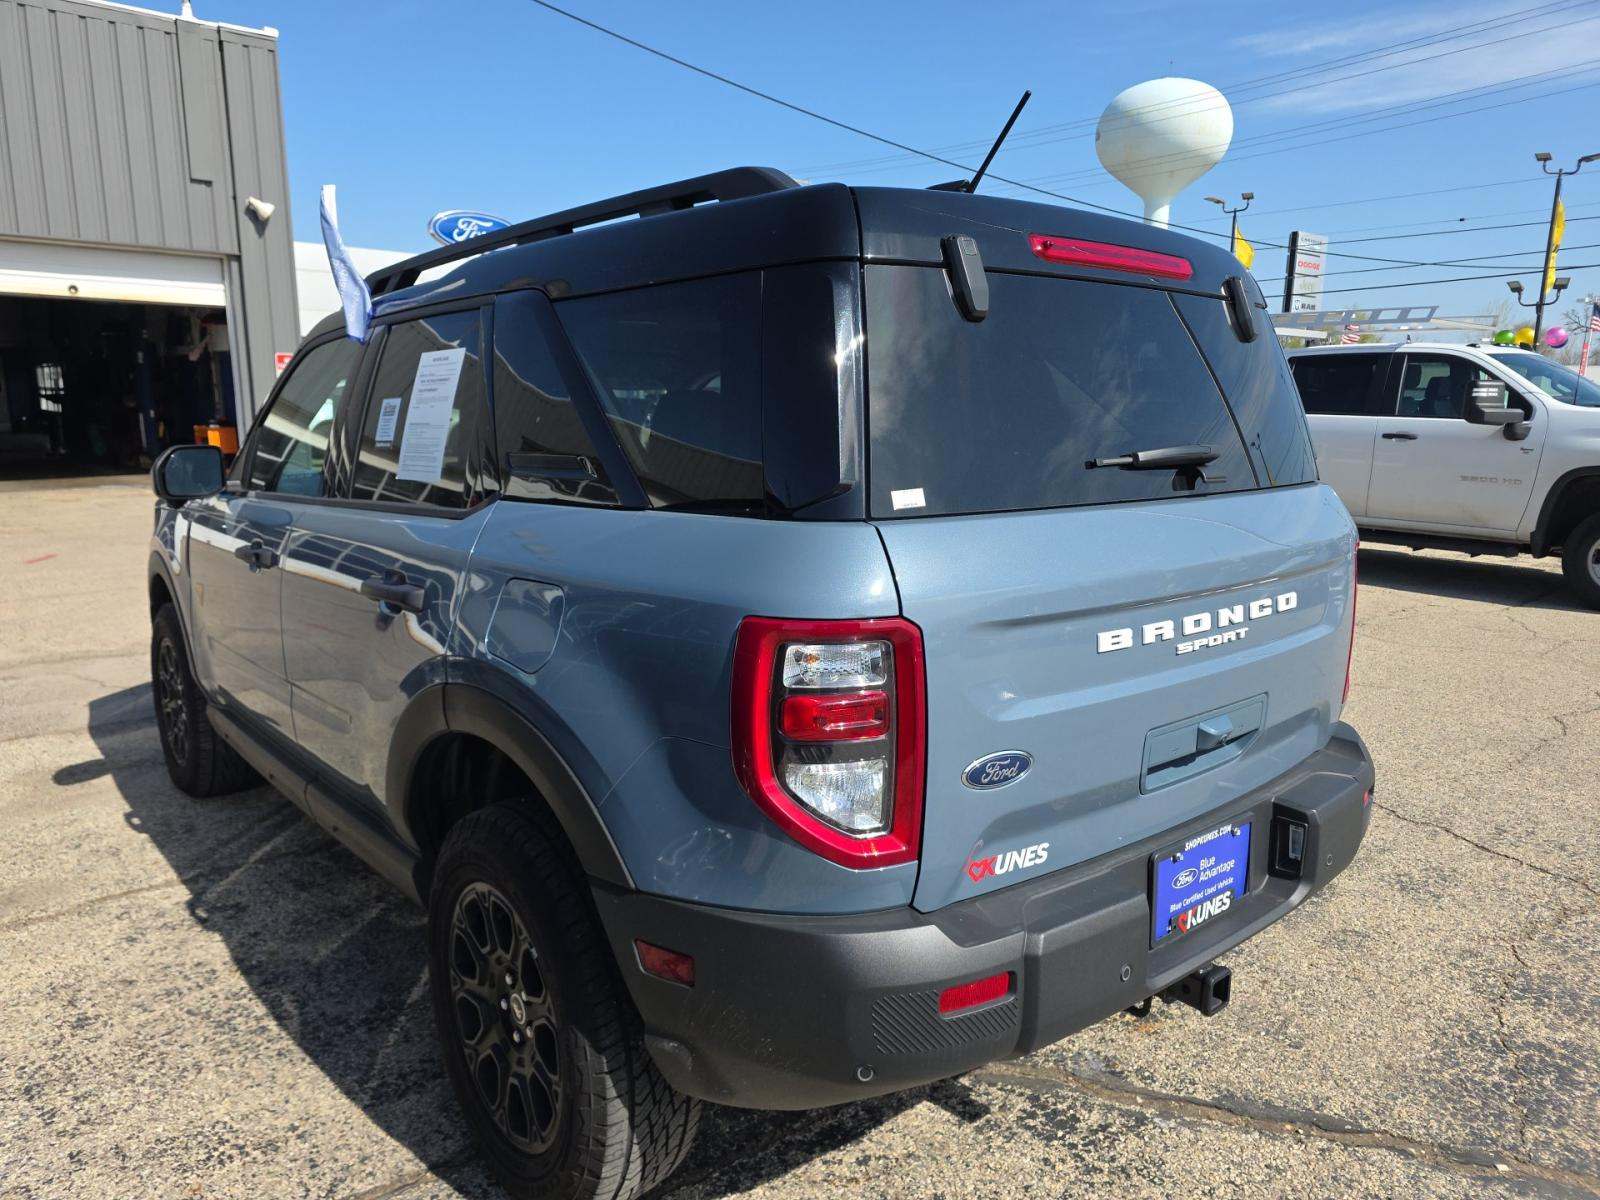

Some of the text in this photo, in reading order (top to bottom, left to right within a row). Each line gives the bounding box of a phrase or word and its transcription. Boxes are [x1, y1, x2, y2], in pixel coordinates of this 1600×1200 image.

[1097, 591, 1298, 653] BRONCO
[1176, 627, 1249, 656] SPORT
[981, 757, 1020, 784] Ford
[1184, 823, 1232, 851] SHOPKUNES.COM
[1199, 856, 1216, 870] Blue
[1199, 860, 1235, 882] Advantage
[1169, 877, 1234, 913] Blue Certified Used Vehicle
